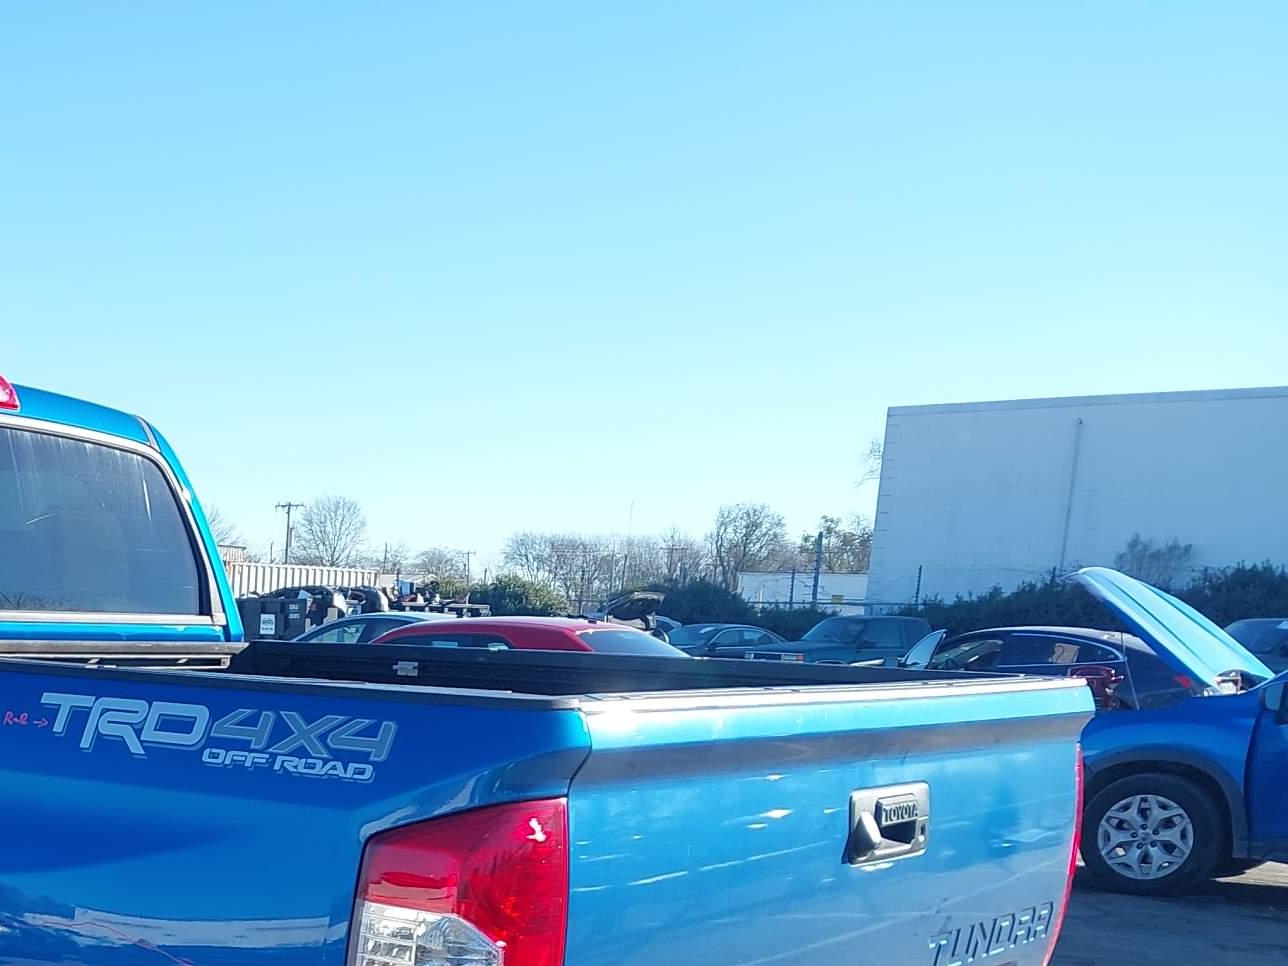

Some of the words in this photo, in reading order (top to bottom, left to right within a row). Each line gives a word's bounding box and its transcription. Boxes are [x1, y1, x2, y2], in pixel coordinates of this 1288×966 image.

[40, 692, 211, 760] TRD
[201, 748, 272, 771] OFF
[272, 757, 376, 783] ROAD
[883, 803, 919, 822] TOYOTA
